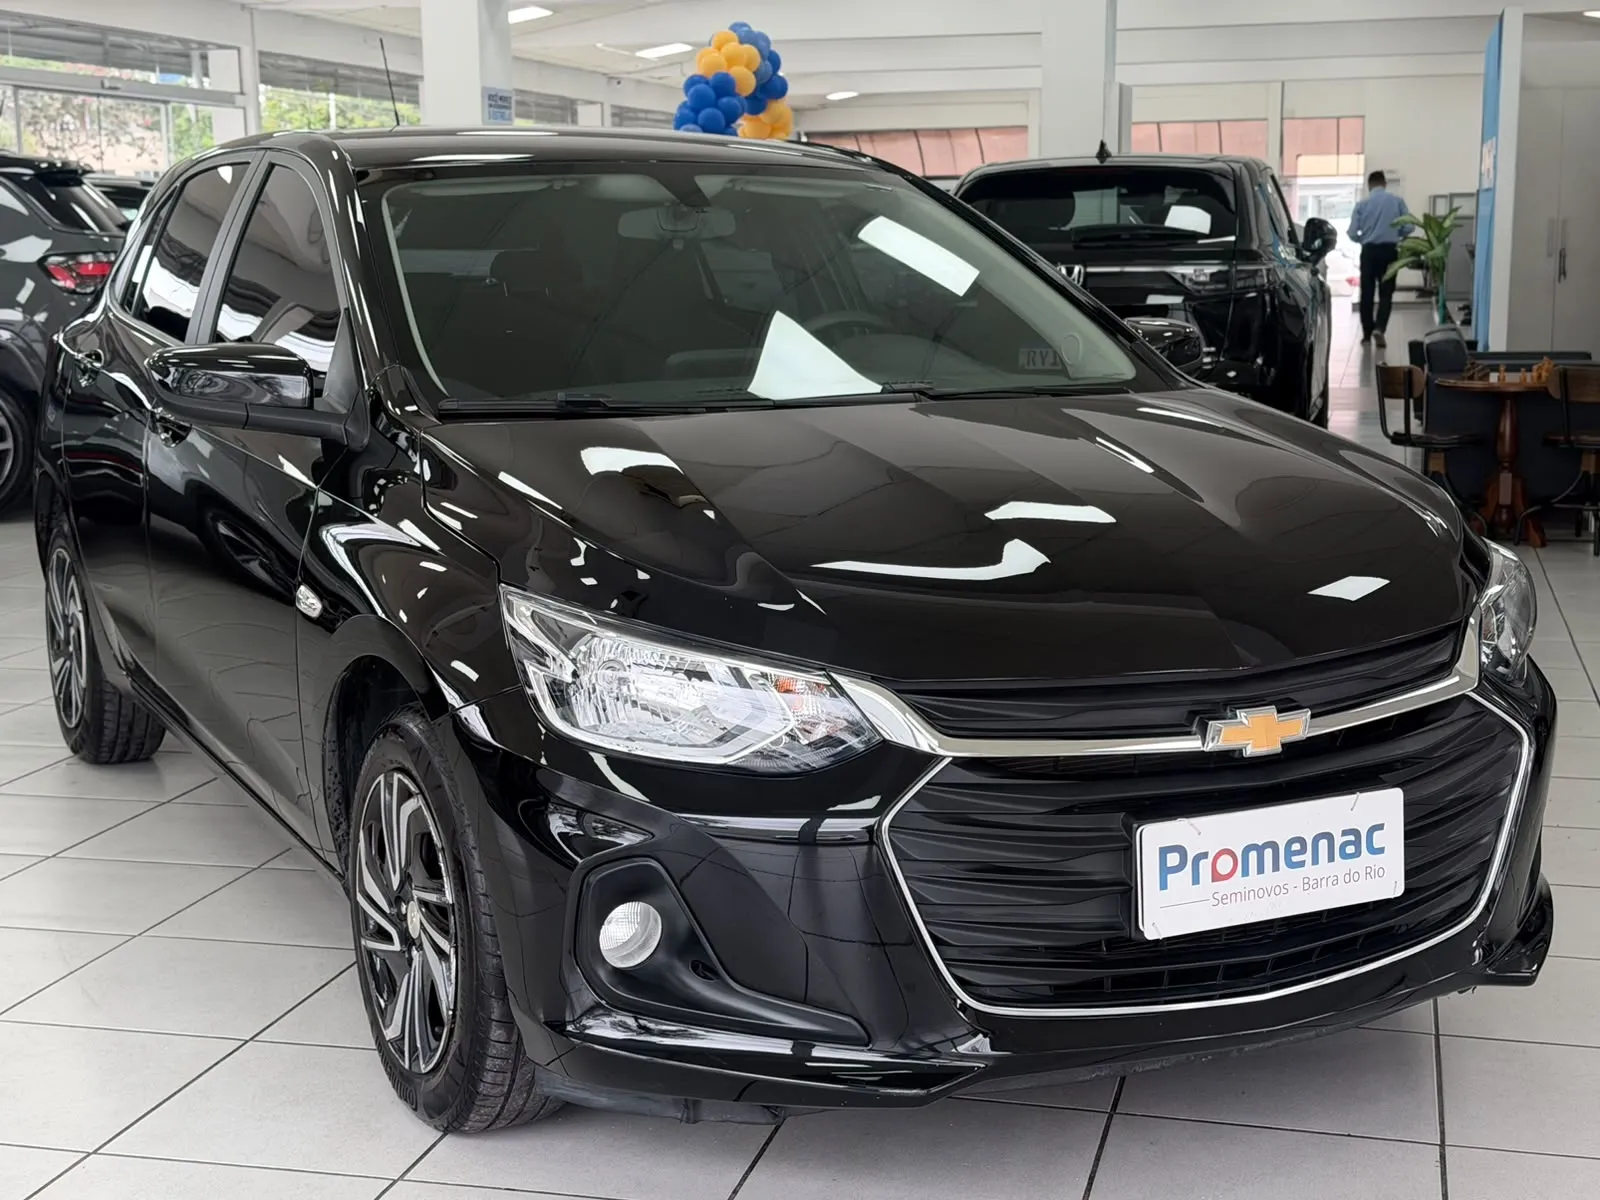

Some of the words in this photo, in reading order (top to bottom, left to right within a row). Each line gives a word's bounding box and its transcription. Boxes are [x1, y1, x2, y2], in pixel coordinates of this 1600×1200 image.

[1158, 823, 1386, 891] Promenac
[1211, 883, 1289, 907] Seminovos
[1302, 873, 1339, 892] Barra
[1343, 868, 1361, 883] do
[1364, 864, 1386, 880] Rio
